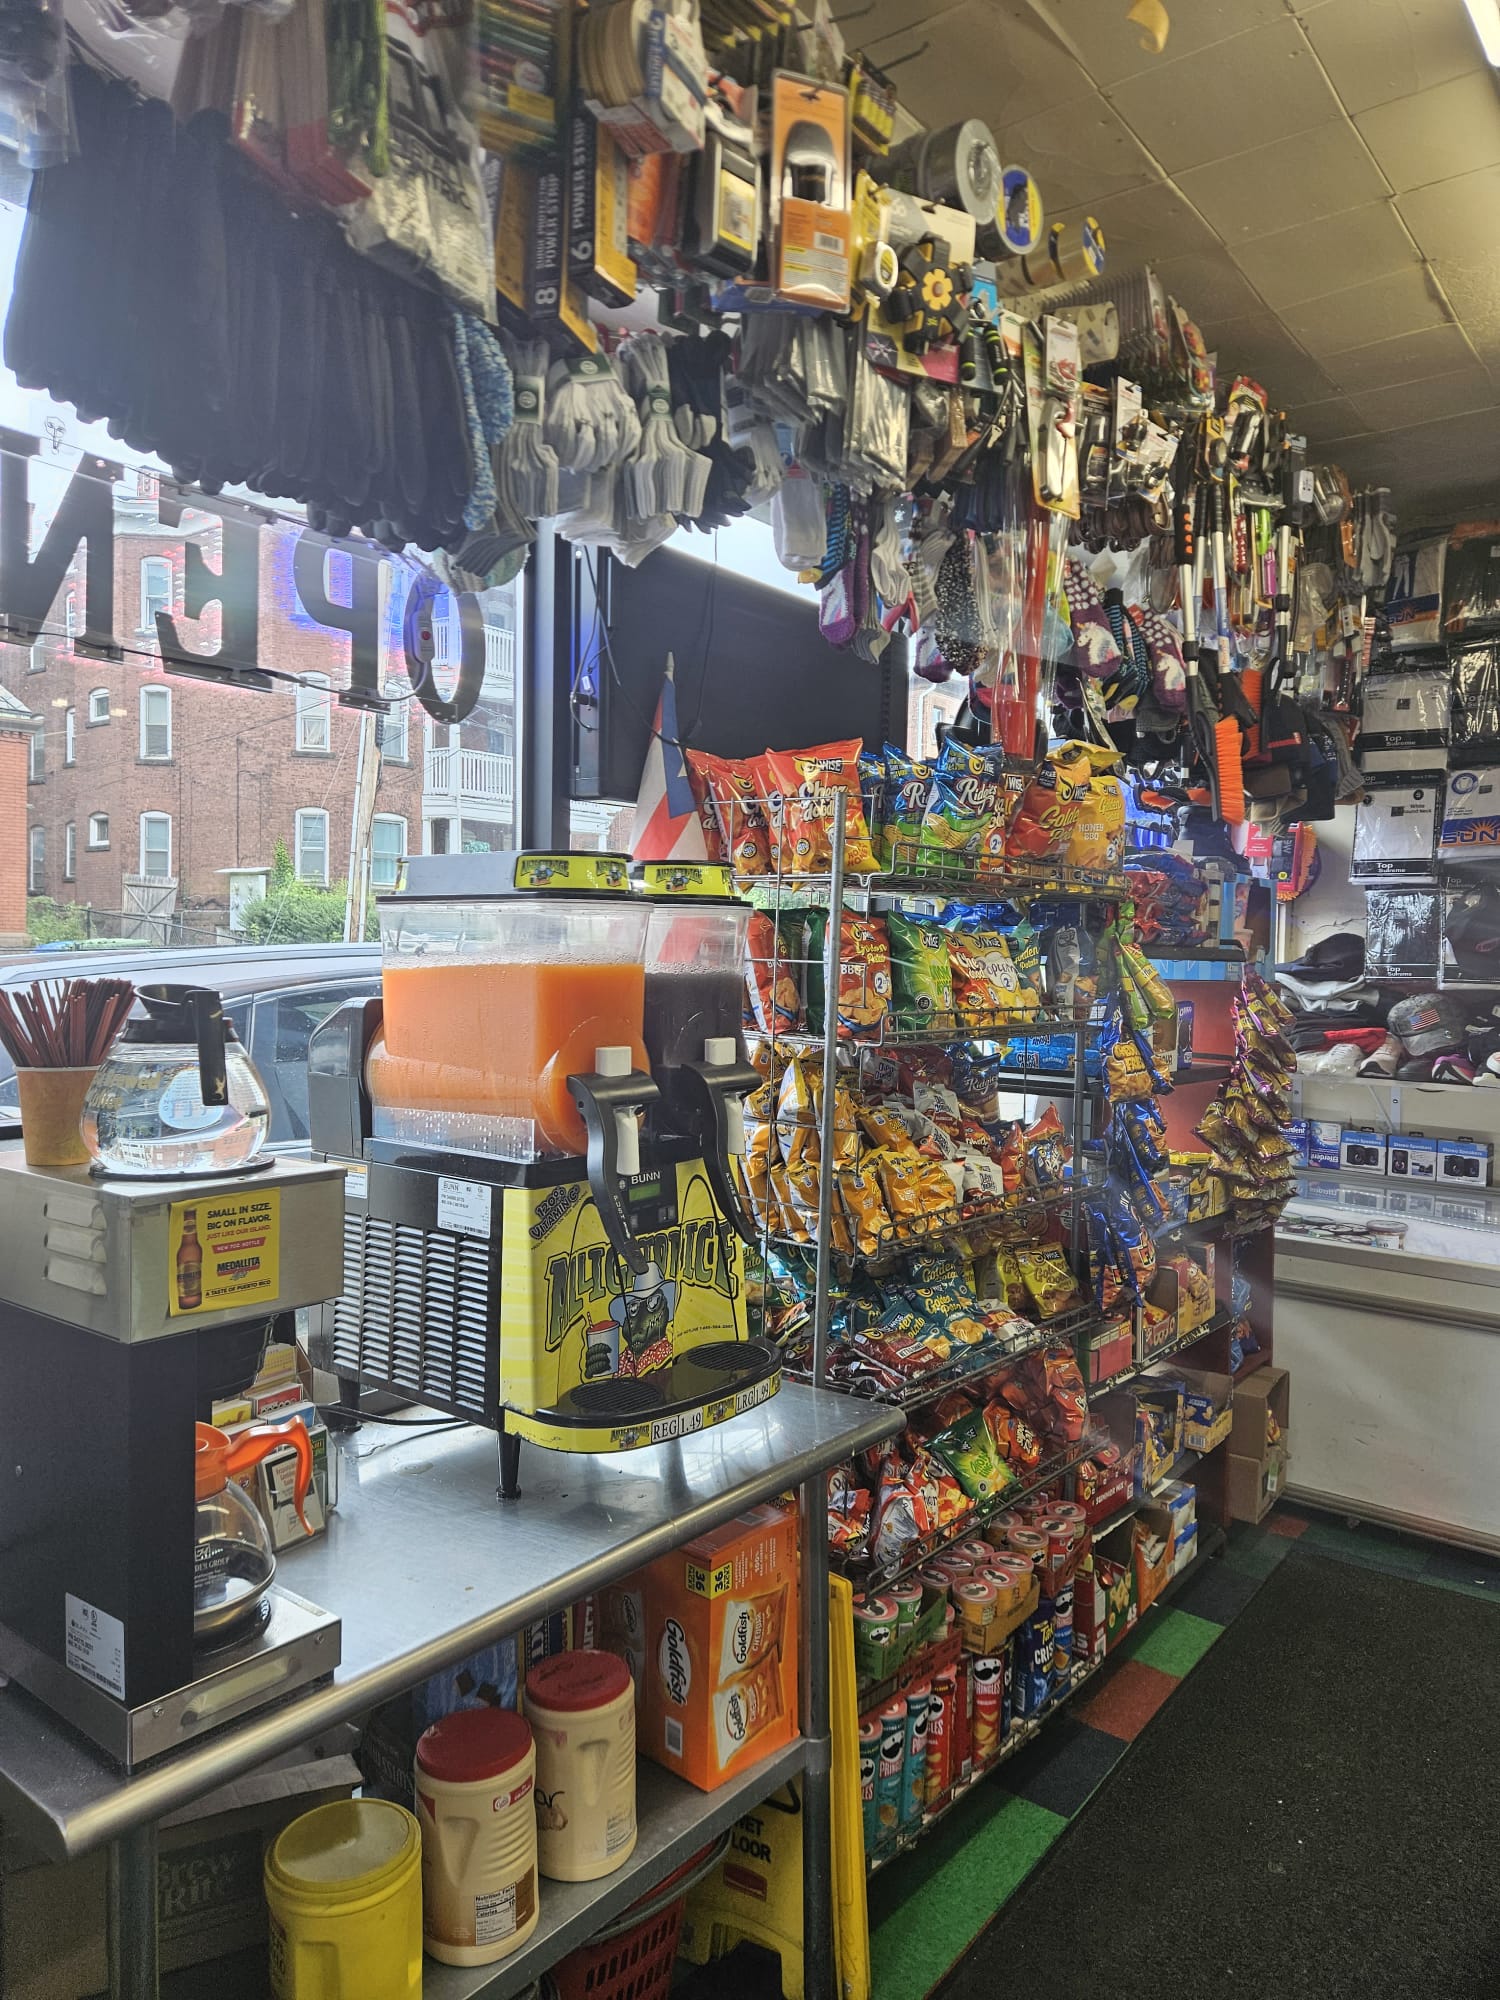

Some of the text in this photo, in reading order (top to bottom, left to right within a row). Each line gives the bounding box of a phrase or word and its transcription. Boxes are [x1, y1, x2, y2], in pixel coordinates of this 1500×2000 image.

[571, 116, 586, 229] POWER STRIP
[545, 172, 558, 269] POWER STRIP
[570, 240, 593, 261] 6
[534, 286, 558, 305] 8
[1384, 735, 1402, 743] Top
[819, 758, 843, 773] WISE
[1041, 770, 1056, 778] FREE
[1008, 776, 1024, 791] WISE
[1040, 804, 1080, 829] Golde
[1078, 823, 1104, 833] HONEY
[1084, 832, 1099, 841] BBQ
[928, 935, 939, 948] WISE
[841, 964, 866, 977] BBQ
[1345, 1136, 1382, 1146] Stereo Speakers
[631, 1170, 661, 1186] BUNN
[207, 1202, 272, 1219] SMALL IN SIZE.
[535, 1184, 566, 1219] 120%
[613, 1195, 625, 1220] PUSH
[207, 1214, 272, 1230] BIG ON FLAVOR.
[529, 1199, 571, 1241] VITAMIN
[206, 1232, 221, 1240] JUST
[221, 1230, 235, 1238] LIKE
[217, 1256, 260, 1273] MEDALLITA
[1045, 1251, 1060, 1260] WISE
[736, 1389, 755, 1414] LRG
[754, 1382, 770, 1404] 1.99
[653, 1418, 678, 1440] REG
[680, 1413, 702, 1436] 1.49
[694, 1570, 705, 1592] 36
[714, 1570, 725, 1593] 36
[736, 1611, 751, 1664] Goldfish
[665, 1618, 687, 1706] Goldfish
[730, 1691, 746, 1741] Goldfish
[731, 1830, 772, 1865] LOOR
[476, 1908, 498, 1919] Calories
